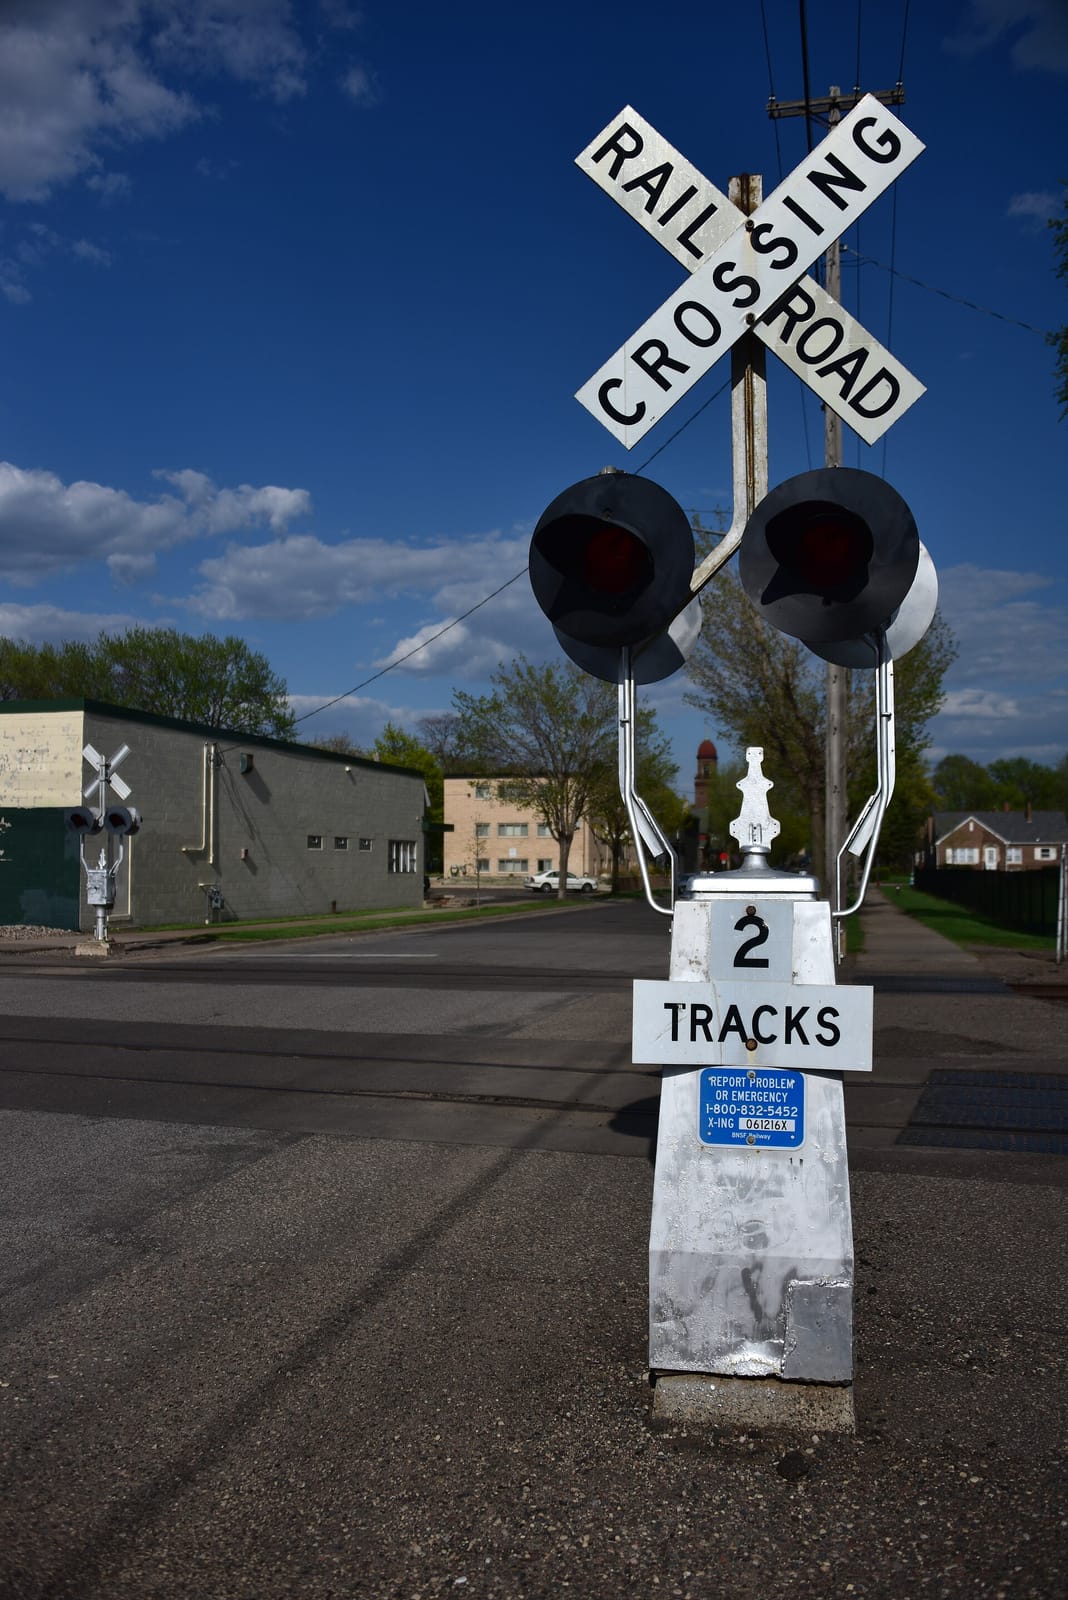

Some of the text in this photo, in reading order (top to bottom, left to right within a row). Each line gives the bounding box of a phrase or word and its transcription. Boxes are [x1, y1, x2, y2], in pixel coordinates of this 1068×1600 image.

[591, 122, 901, 419] RAIL ROAD
[597, 116, 901, 426] CROSSING
[733, 915, 770, 969] 2
[663, 1002, 841, 1048] TRACKS
[710, 1076, 794, 1089] REPORT PROBLEM
[715, 1090, 788, 1103] OR EMERGENCY
[705, 1103, 799, 1117] 1-800-832-5452
[708, 1117, 788, 1131] X-ING 061216X
[731, 1131, 747, 1139] BNSF
